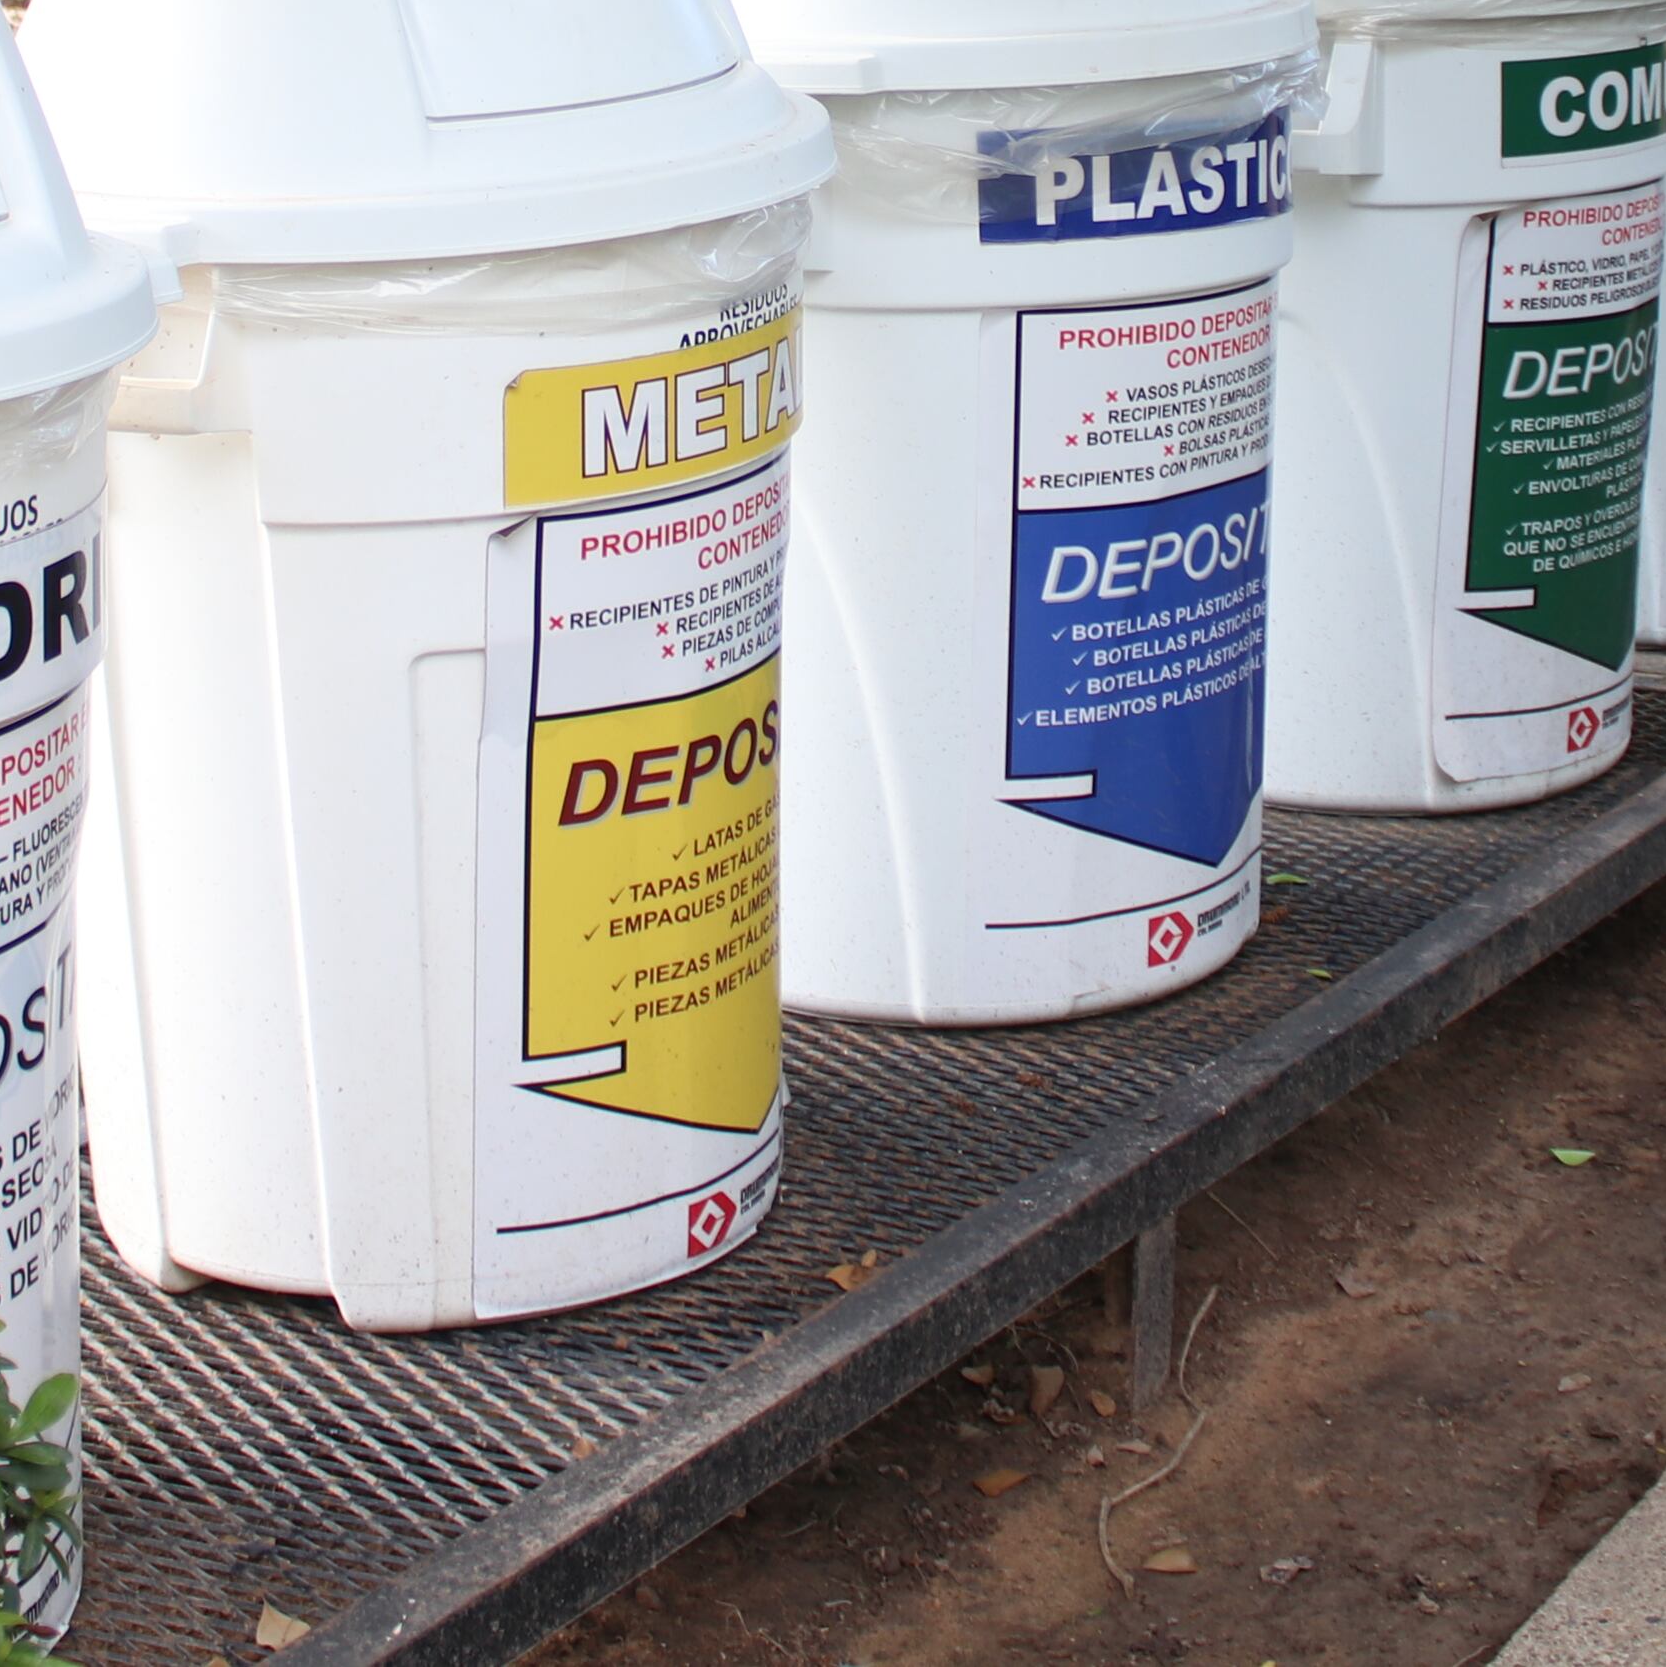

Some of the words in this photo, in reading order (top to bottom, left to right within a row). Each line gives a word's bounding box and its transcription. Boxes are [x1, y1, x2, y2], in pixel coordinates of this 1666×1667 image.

[1523, 206, 1622, 228] PROHIBIDO
[1059, 320, 1196, 350] PROHIBIDO
[1040, 466, 1154, 489] RECIPIENTES
[1160, 457, 1186, 478] CON
[1191, 446, 1238, 472] PINTURA
[581, 508, 727, 559] PROHIBIDO
[1522, 516, 1582, 536] TRAPOS
[1504, 541, 1539, 557] QUE
[1544, 538, 1566, 552] NO
[570, 592, 694, 629] RECIPIENTES
[700, 583, 718, 604] DE
[723, 561, 768, 596] PINTURA
[1072, 611, 1170, 642] BOTELLAS
[609, 892, 726, 937] EMPAQUES
[731, 875, 748, 902] DE
